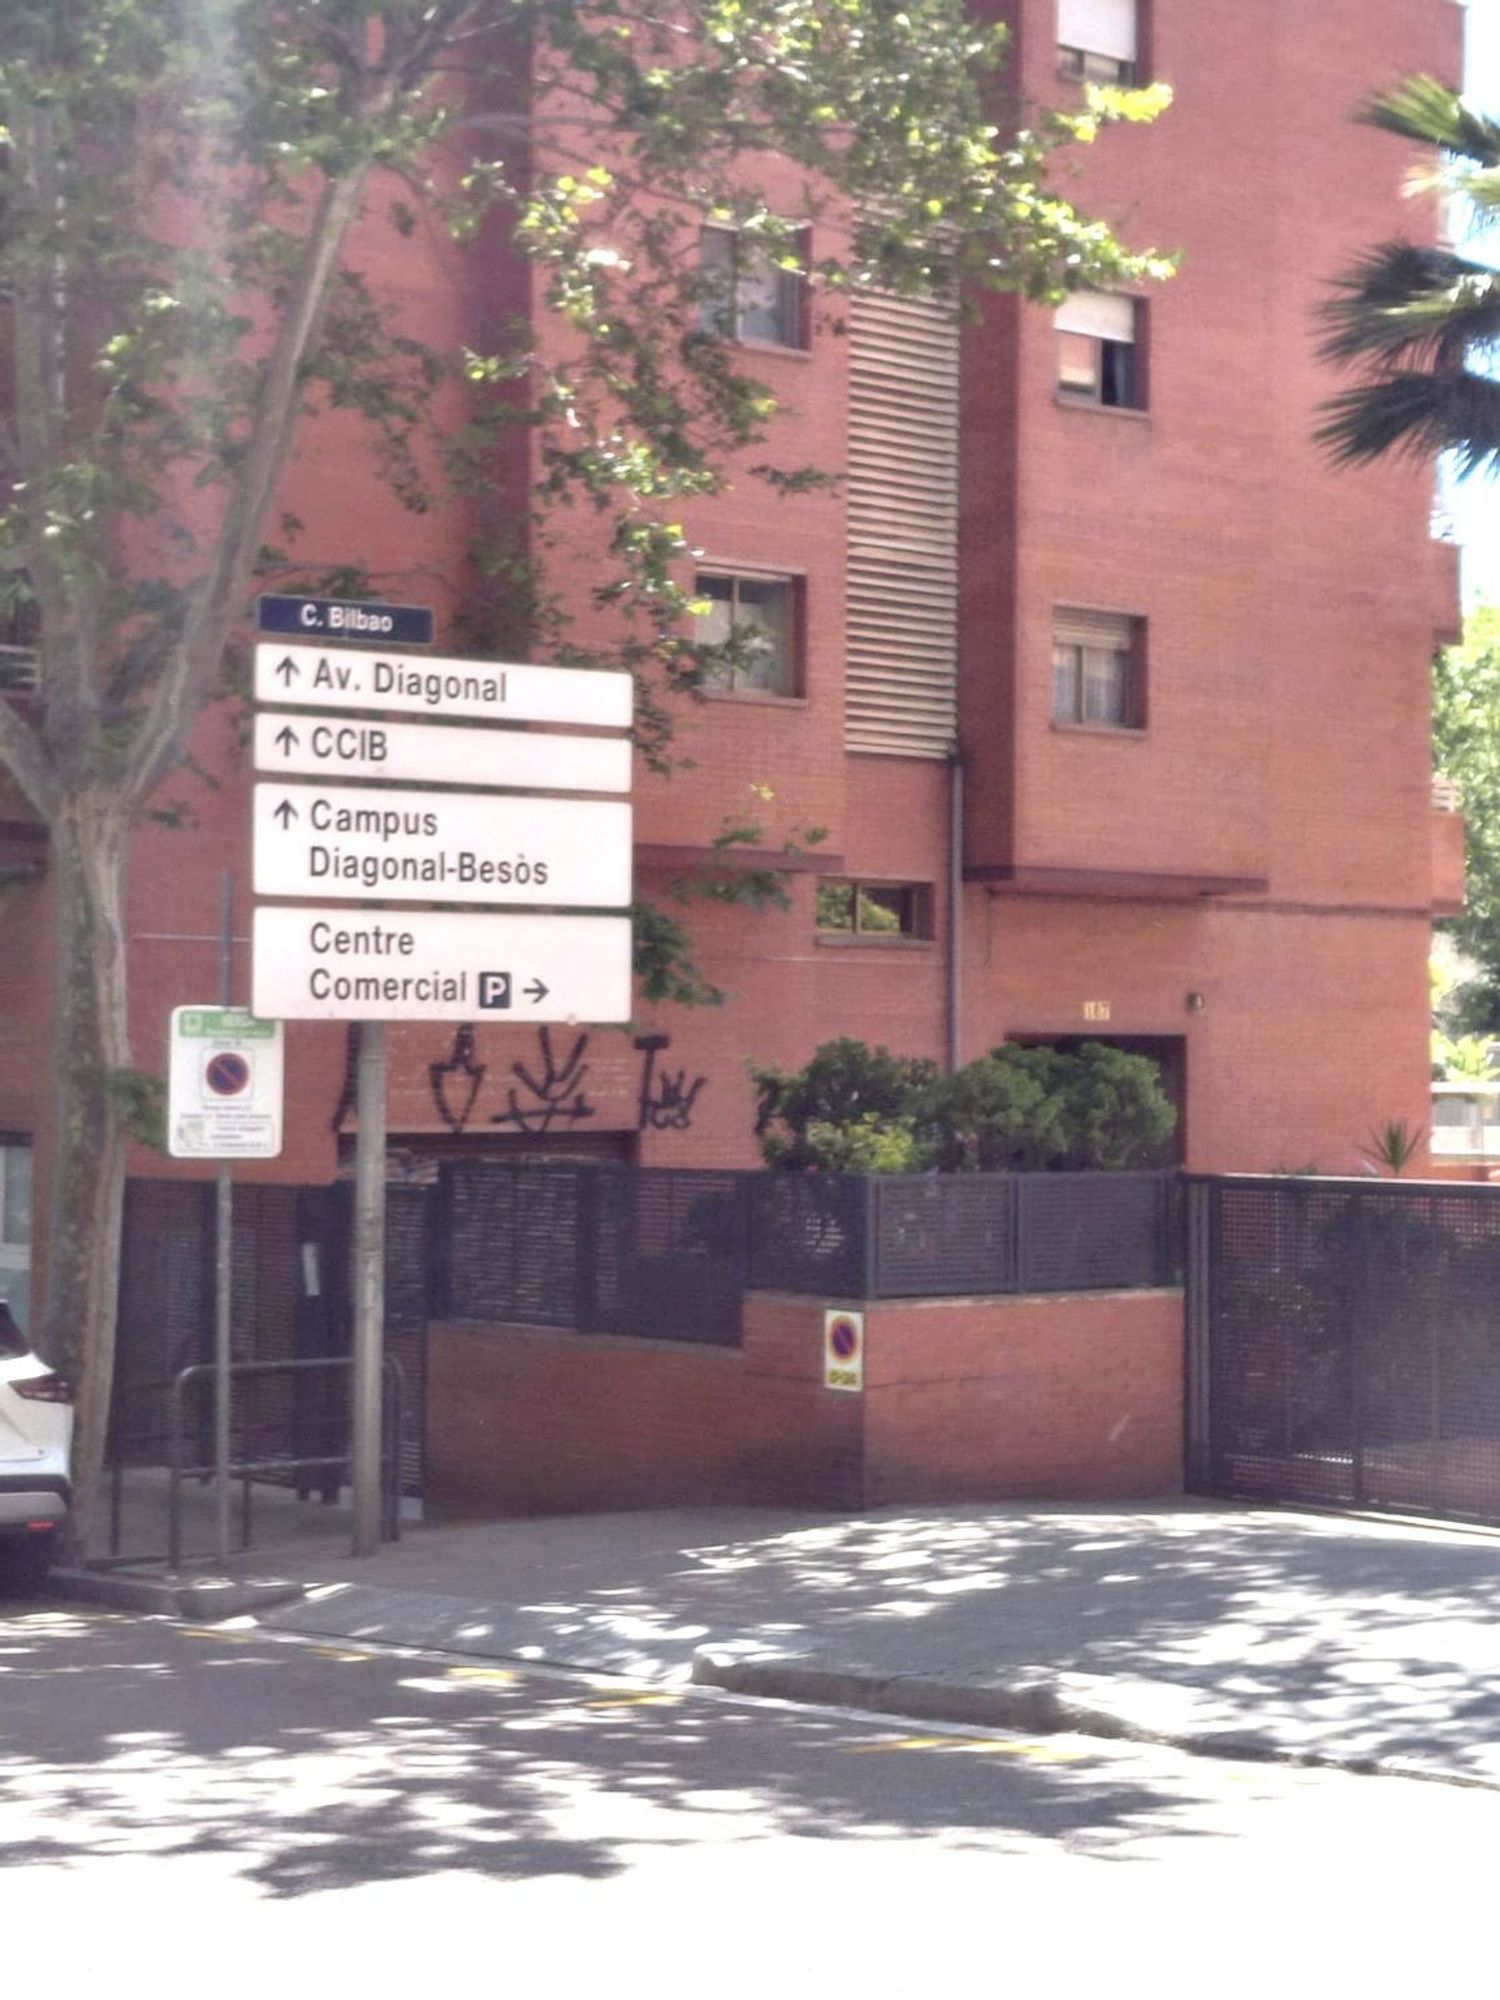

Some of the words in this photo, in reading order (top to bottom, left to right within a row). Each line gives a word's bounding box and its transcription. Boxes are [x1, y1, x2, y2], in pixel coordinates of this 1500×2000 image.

[300, 603, 323, 627] C.
[328, 605, 394, 632] Bilbao
[312, 657, 361, 692] Av.
[373, 662, 507, 704] Diagonal
[312, 726, 388, 762] CCIB
[310, 799, 438, 842] Campus
[309, 846, 549, 887] Diagonal-Besòs
[310, 922, 415, 956] Centre
[309, 968, 467, 1002] Comercial
